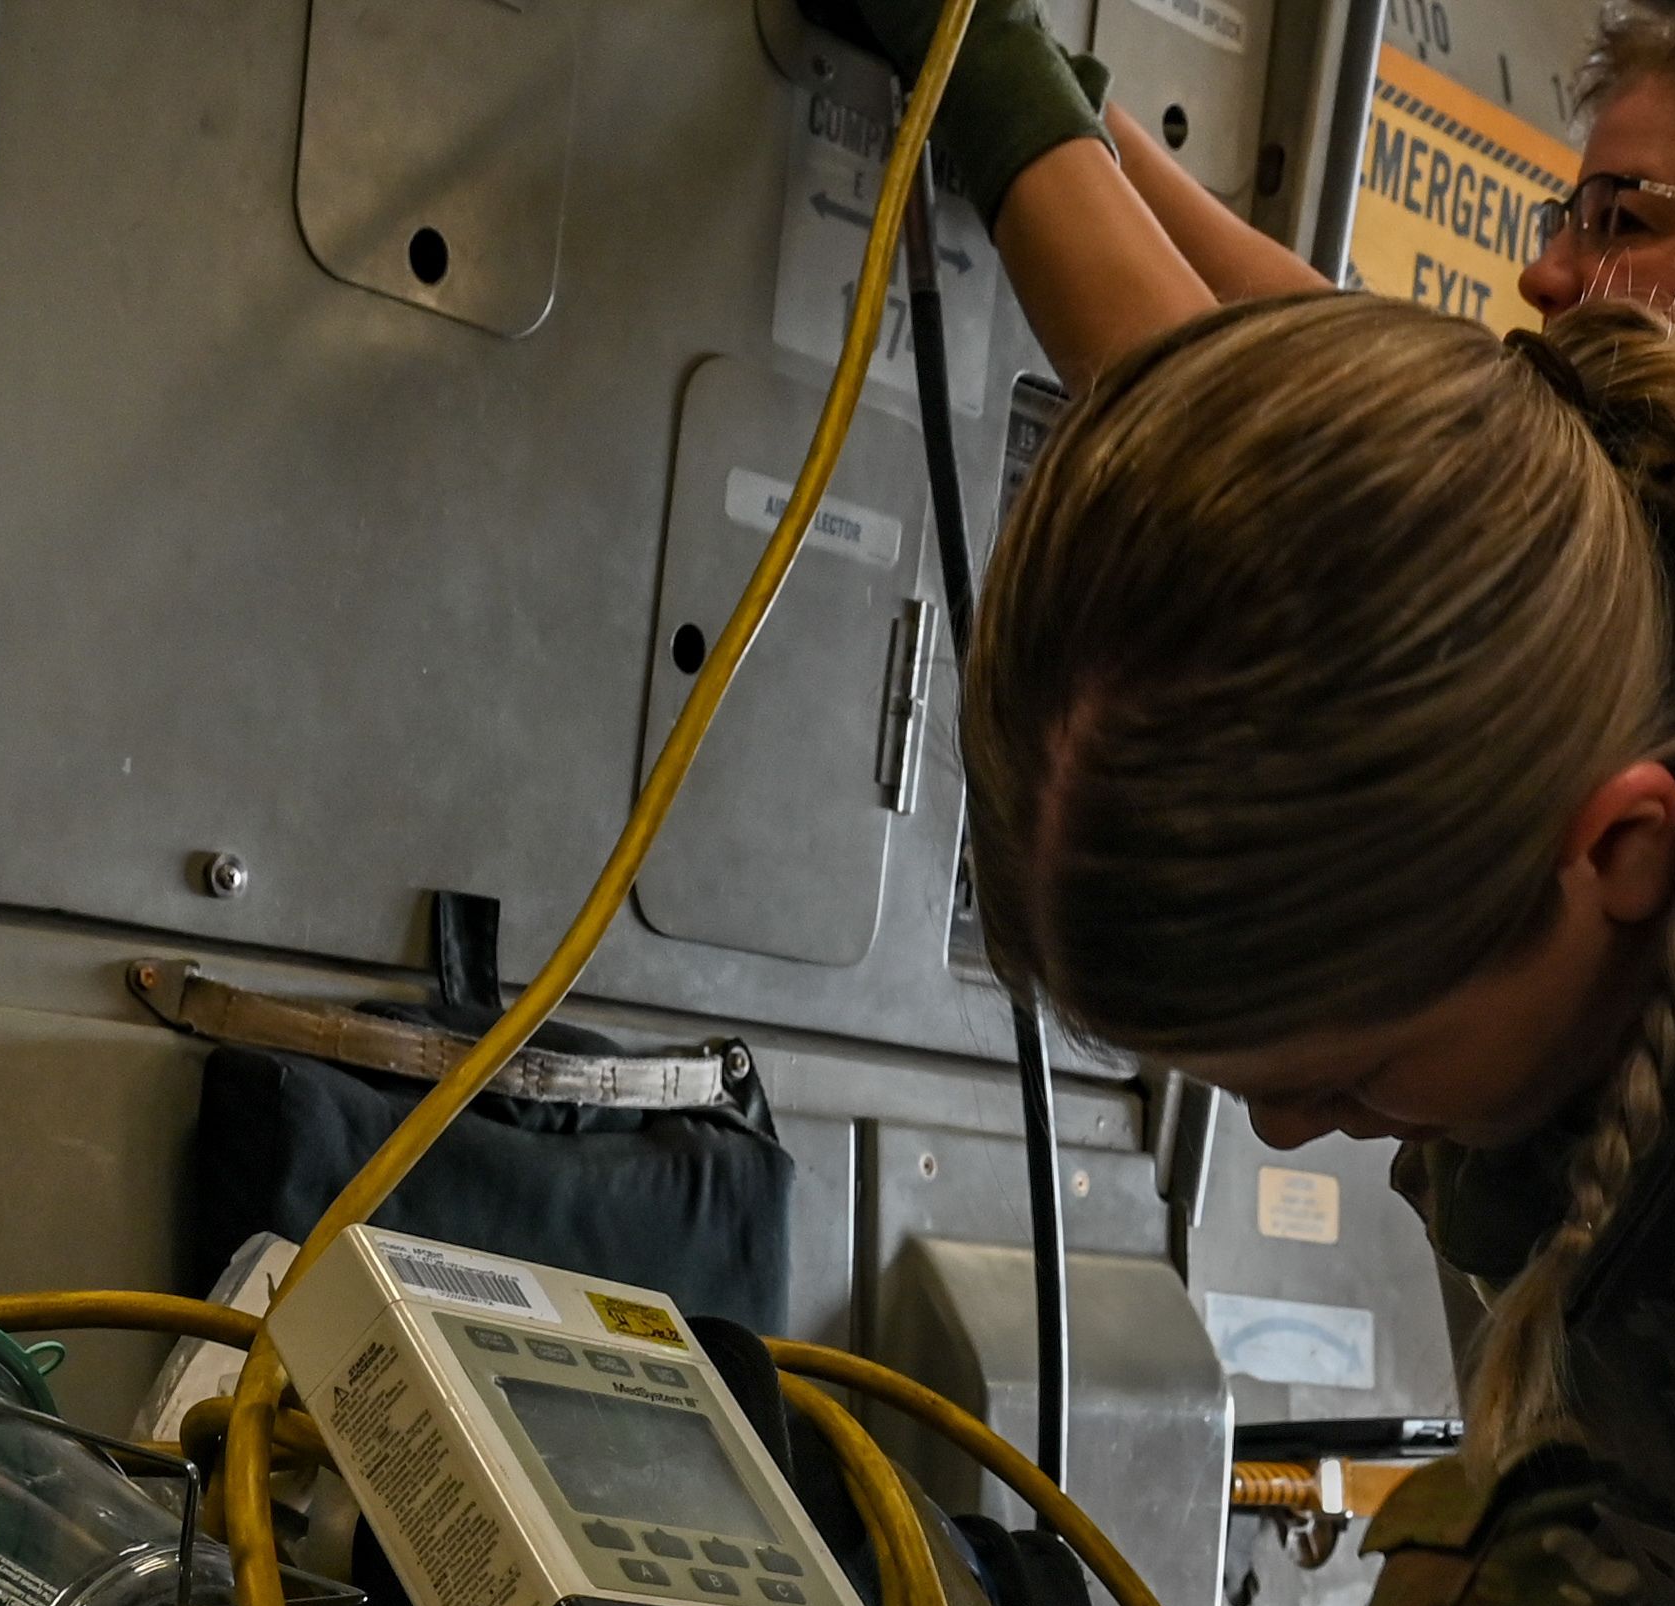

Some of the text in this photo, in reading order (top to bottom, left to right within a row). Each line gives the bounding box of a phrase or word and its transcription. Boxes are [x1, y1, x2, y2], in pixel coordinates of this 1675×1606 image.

[1359, 112, 1549, 266] MERGENC
[814, 509, 862, 542] LECTOR
[611, 1380, 683, 1403] MedSystem
[639, 1564, 654, 1579] A
[708, 1574, 723, 1589] B
[775, 1583, 790, 1598] C
